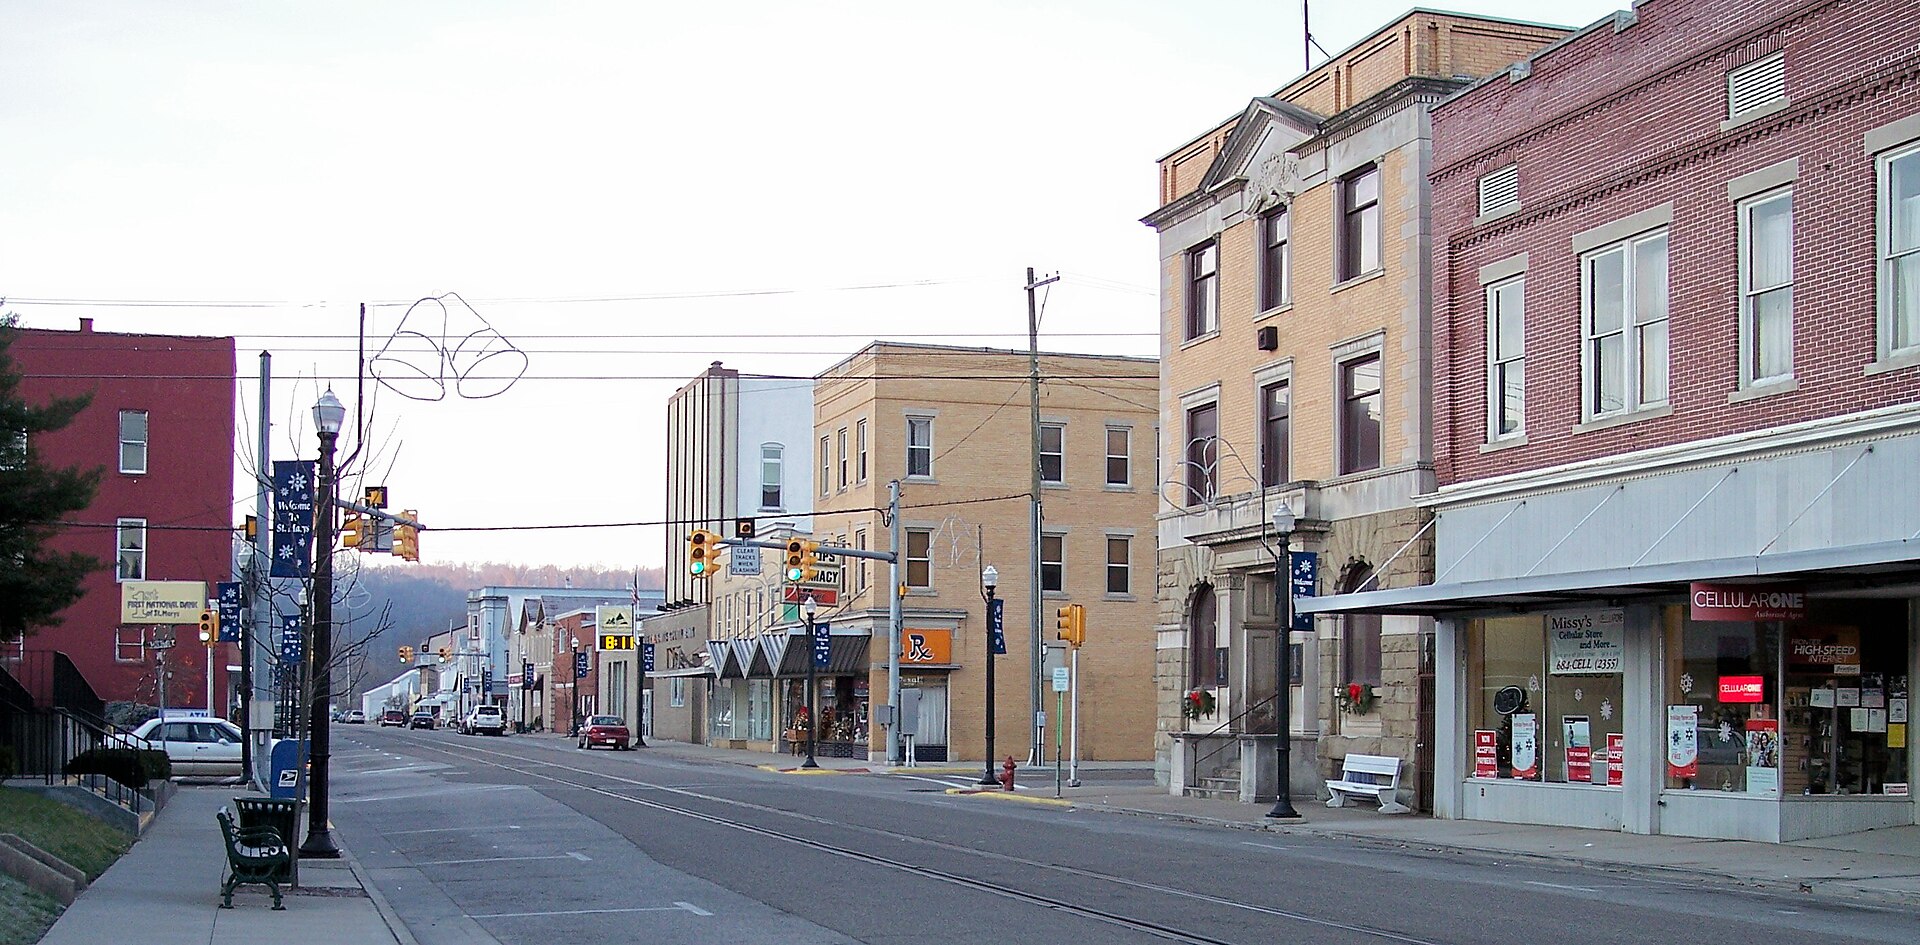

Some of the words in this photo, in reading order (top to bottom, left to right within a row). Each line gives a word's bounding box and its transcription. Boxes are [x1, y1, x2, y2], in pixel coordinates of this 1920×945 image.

[1694, 591, 1804, 608] CELLULARONE
[127, 601, 145, 609] FIRST
[146, 601, 178, 609] NATIONAL
[179, 601, 198, 609] BANK
[1552, 615, 1592, 630] Missy's
[1558, 630, 1583, 639] Cellular
[1585, 630, 1603, 638] Store
[605, 635, 635, 650] 8:11
[1580, 640, 1592, 649] and
[1594, 657, 1619, 670] (2355)
[1808, 655, 1847, 663] INTERNET
[1720, 684, 1762, 693] CELLULARONE
